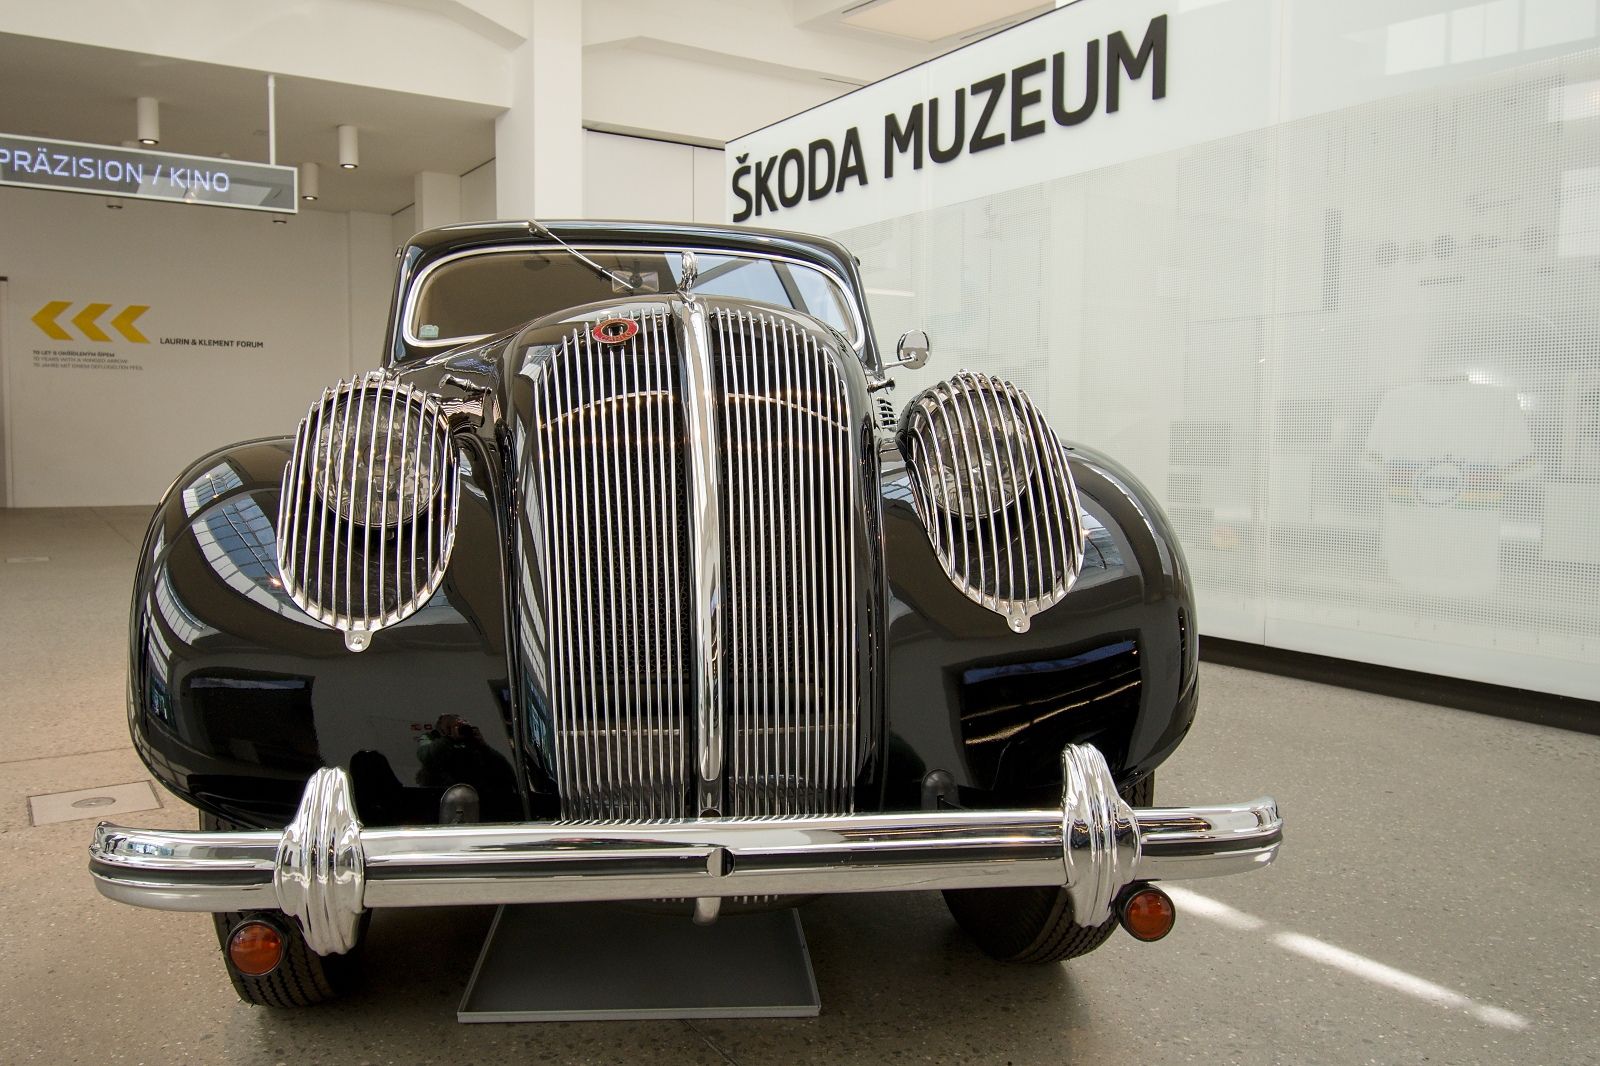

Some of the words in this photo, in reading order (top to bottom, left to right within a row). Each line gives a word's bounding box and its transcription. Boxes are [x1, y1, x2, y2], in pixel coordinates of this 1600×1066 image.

[732, 127, 868, 222] ŠKODA
[884, 14, 1167, 178] MUZEUM
[171, 167, 230, 192] KINO
[160, 338, 190, 346] LAURIN
[198, 339, 234, 348] KLEMENT
[236, 341, 264, 349] FORUM
